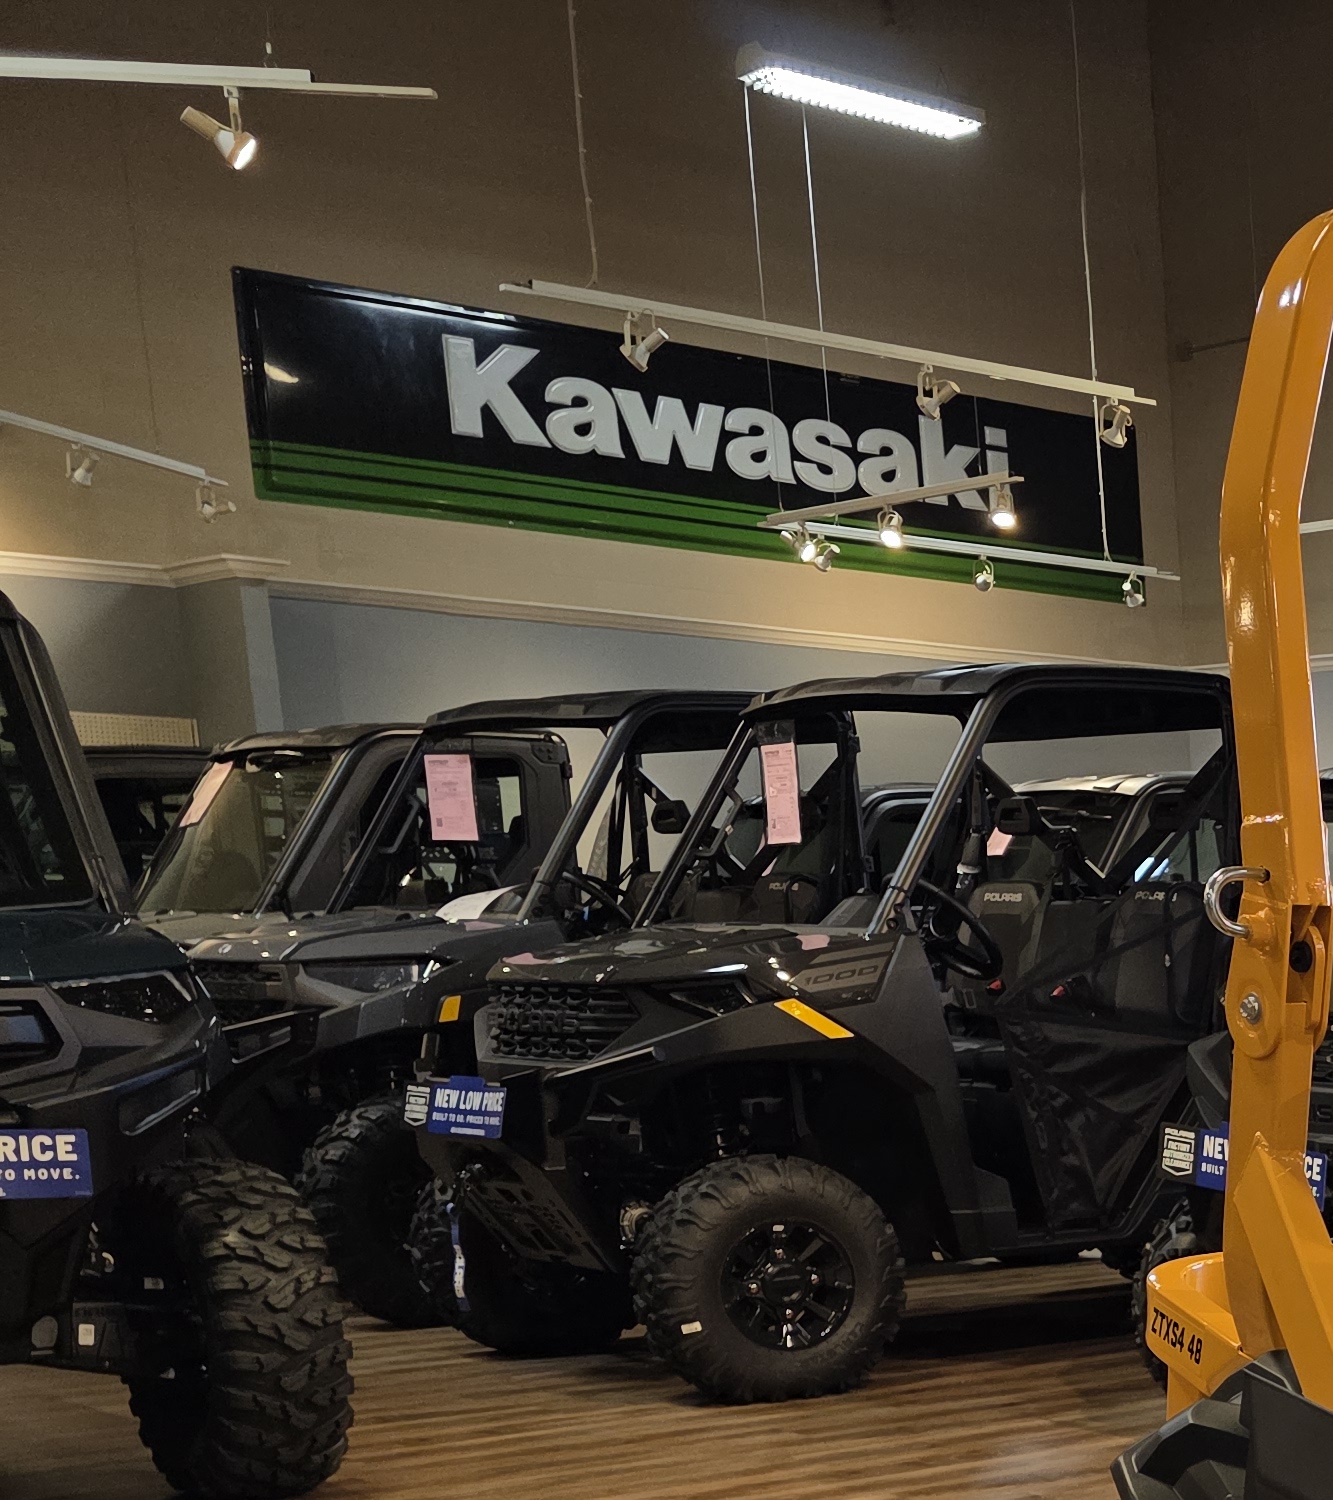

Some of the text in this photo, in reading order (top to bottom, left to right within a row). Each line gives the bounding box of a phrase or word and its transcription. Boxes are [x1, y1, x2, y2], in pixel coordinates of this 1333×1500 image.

[441, 333, 1010, 513] Kawasaki
[984, 892, 1022, 902] POLARIS
[434, 1088, 459, 1109] NEW
[459, 1090, 482, 1111] LOW
[481, 1092, 505, 1112] PRICE
[0, 1134, 78, 1162] RICE
[23, 1167, 80, 1180] MOVE.
[1201, 1163, 1224, 1176] BUILT
[1151, 1306, 1203, 1365] ZTXS4 48
